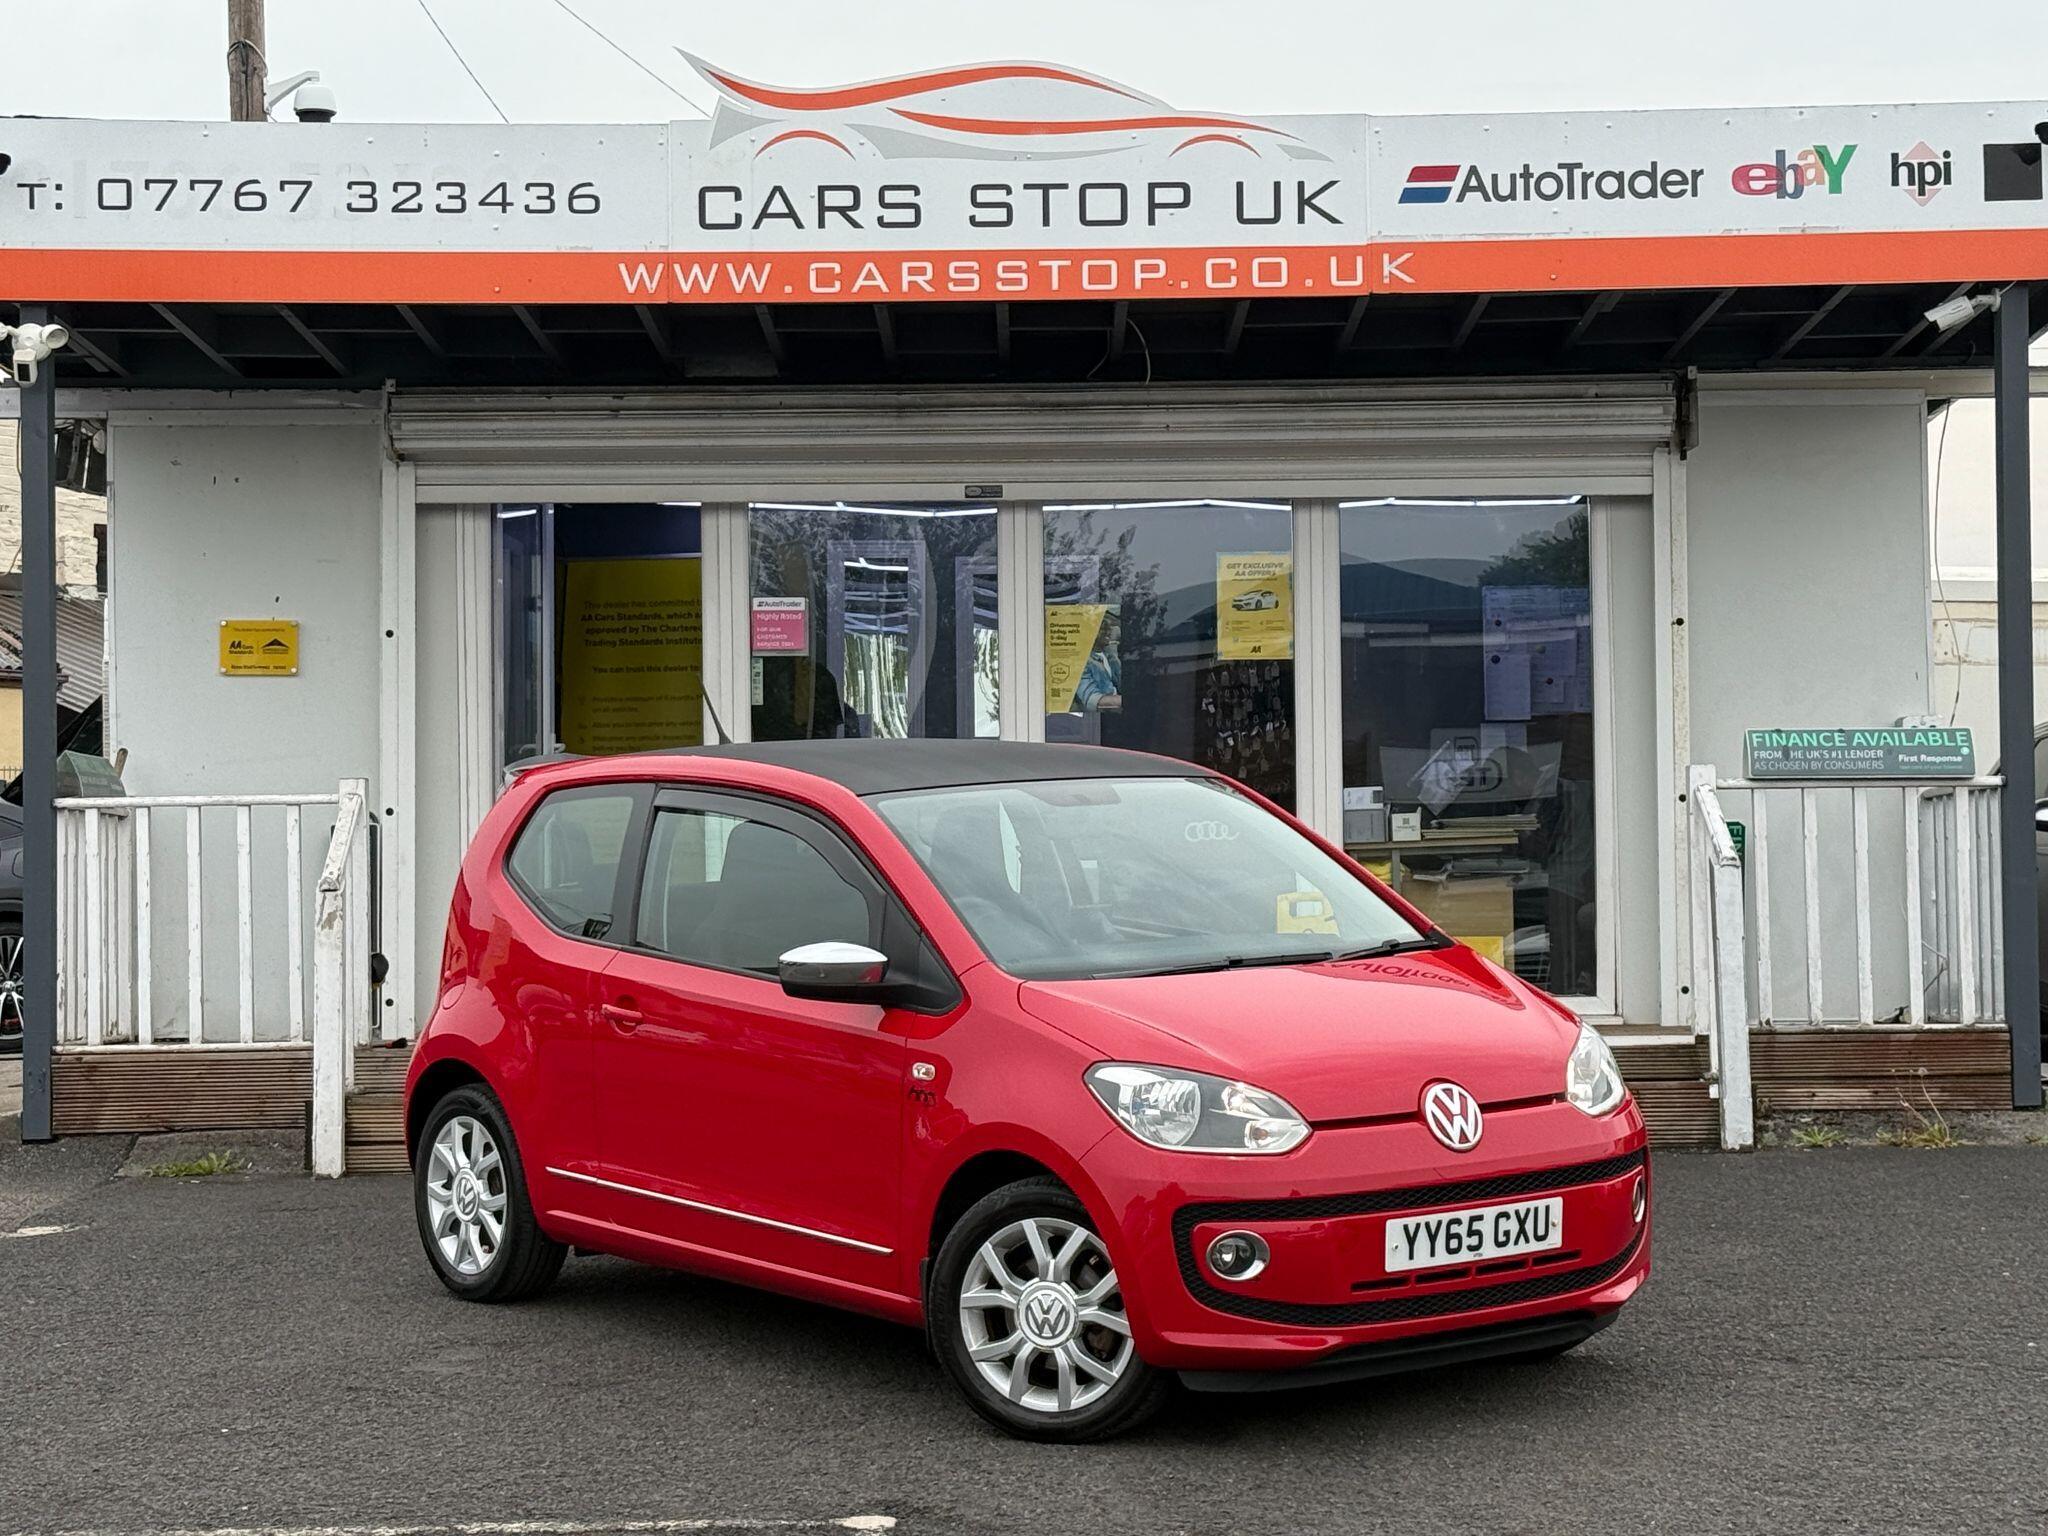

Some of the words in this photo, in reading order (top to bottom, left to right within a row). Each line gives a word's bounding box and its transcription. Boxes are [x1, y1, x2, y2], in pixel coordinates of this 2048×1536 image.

[1456, 161, 1704, 203] AutoTrader
[1891, 151, 1953, 197] hpi
[97, 178, 313, 213] 07767
[345, 180, 602, 215] 323436
[698, 184, 922, 231] CARS
[968, 180, 1190, 228] STOP
[1235, 179, 1343, 226] UK
[757, 613, 779, 621] Highly
[1752, 733, 1847, 747] FINANCE
[1853, 732, 1969, 747] AVAILABLE
[1754, 751, 1782, 759] FROM
[1784, 750, 1804, 759] HE
[1806, 750, 1829, 759] UK'S
[1845, 750, 1884, 758] LENDER
[1754, 761, 1767, 770] AS
[1769, 761, 1808, 769] CHOSEN
[1811, 761, 1823, 769] BY
[1824, 761, 1885, 769] CONSUMERS
[1898, 754, 1919, 762] First
[1920, 755, 1962, 764] Response
[1402, 1214, 1485, 1261] YY65
[1493, 1204, 1550, 1249] GXU
